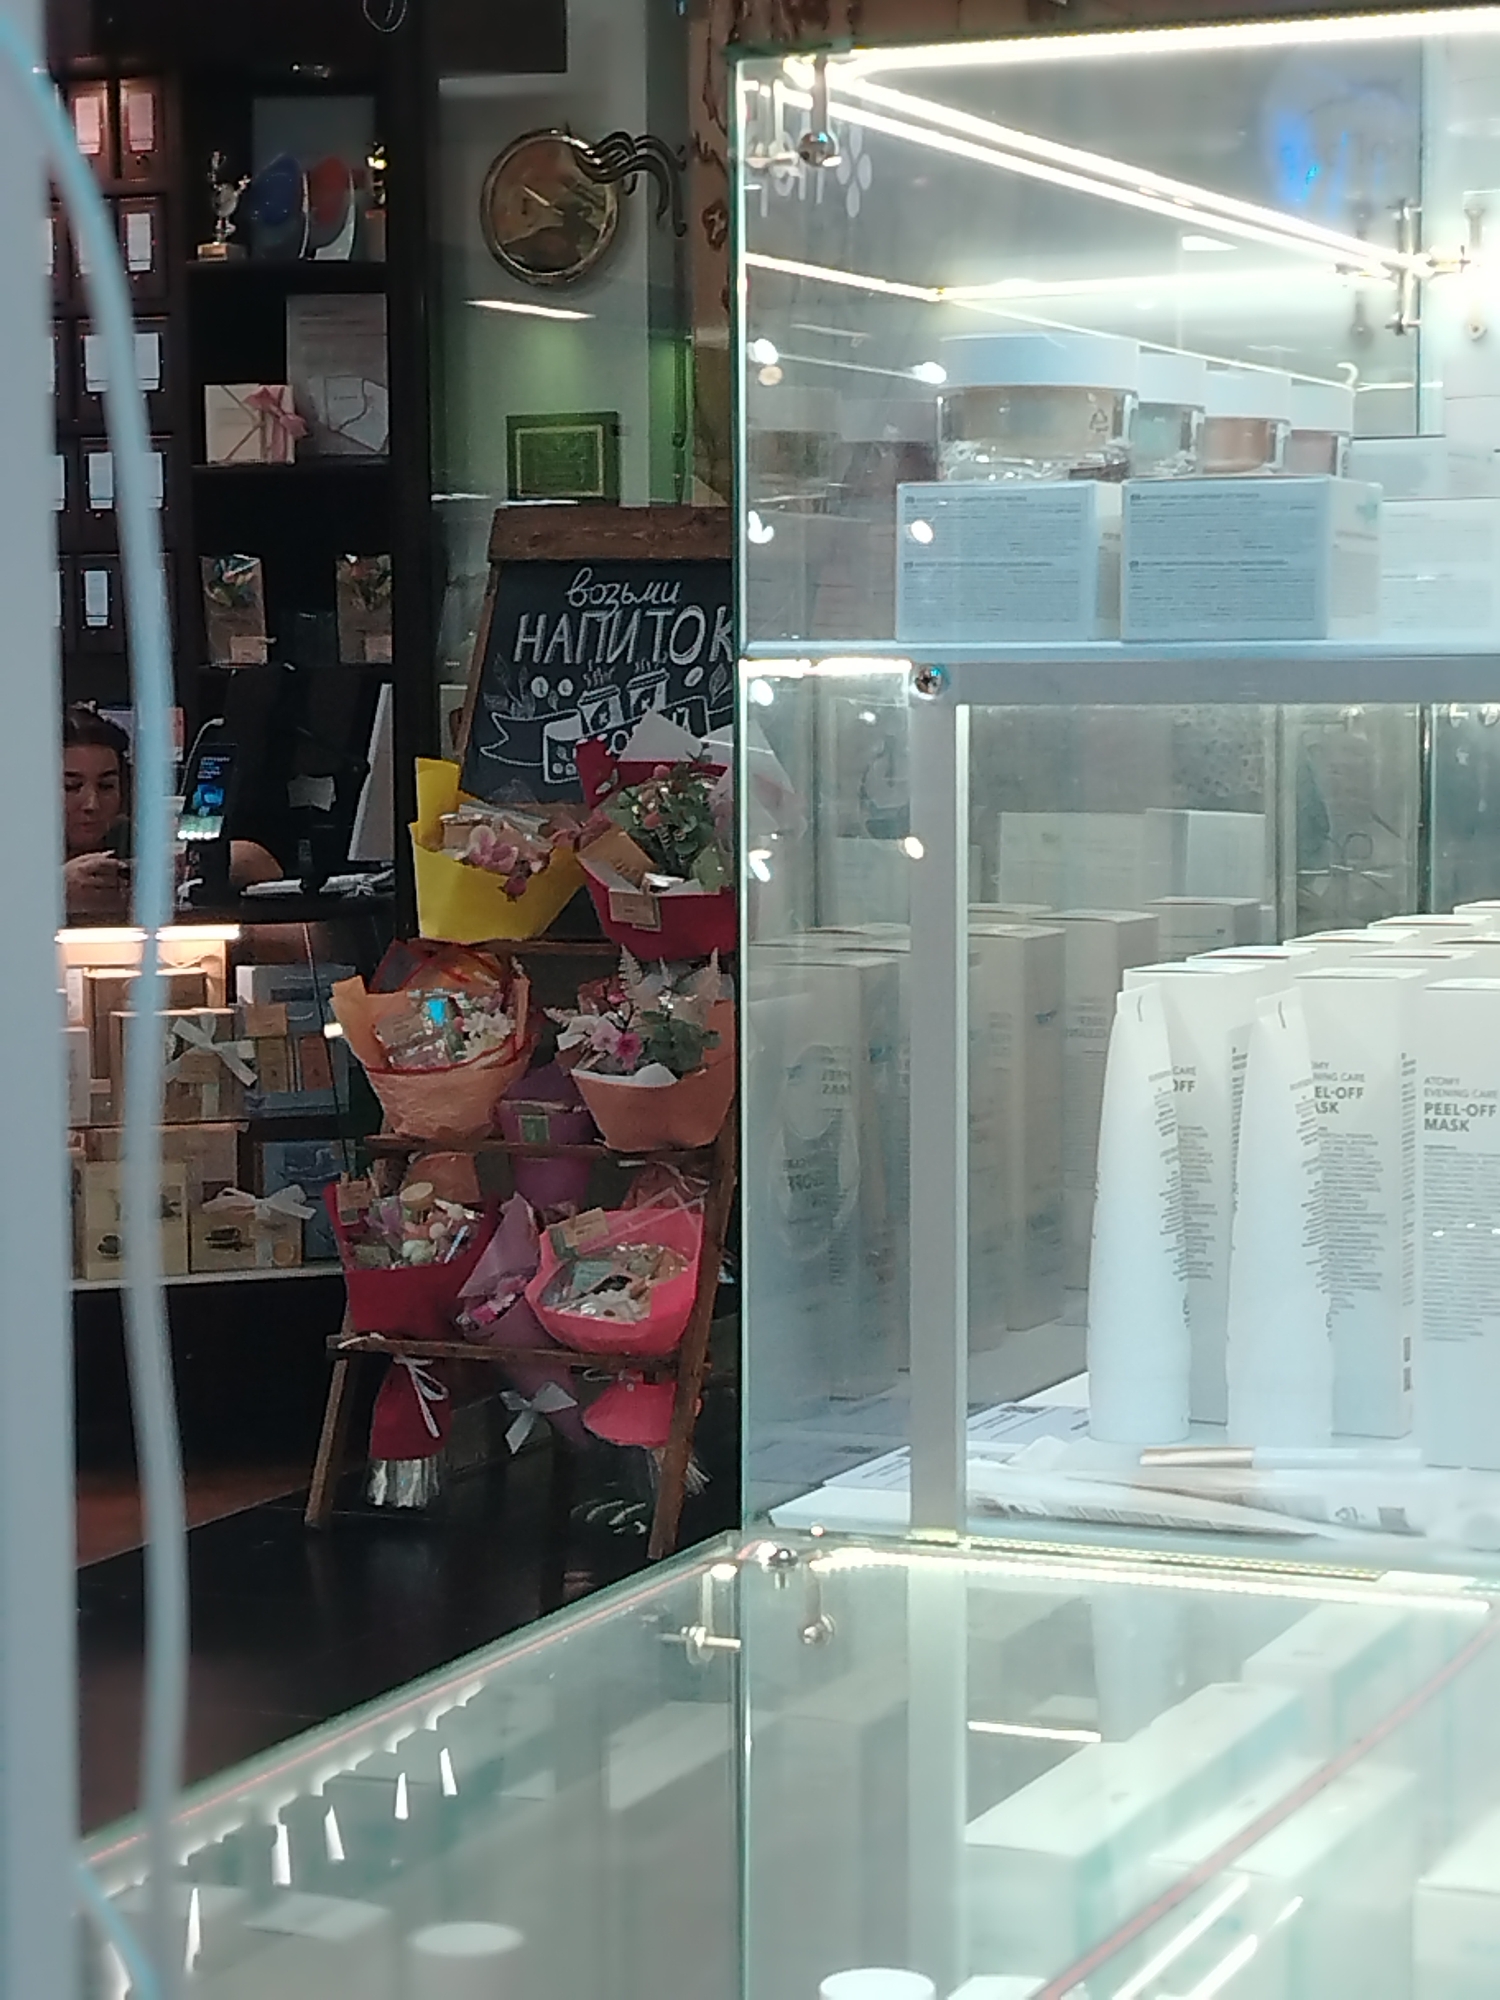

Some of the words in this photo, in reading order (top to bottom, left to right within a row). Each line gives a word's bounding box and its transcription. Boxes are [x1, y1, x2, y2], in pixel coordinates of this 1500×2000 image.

[565, 567, 681, 621] возьми
[513, 605, 733, 665] НАПИТОК
[1314, 1086, 1364, 1100] EL-OFF
[1424, 1102, 1497, 1117] PEEL-OFF
[1424, 1118, 1470, 1132] MASK
